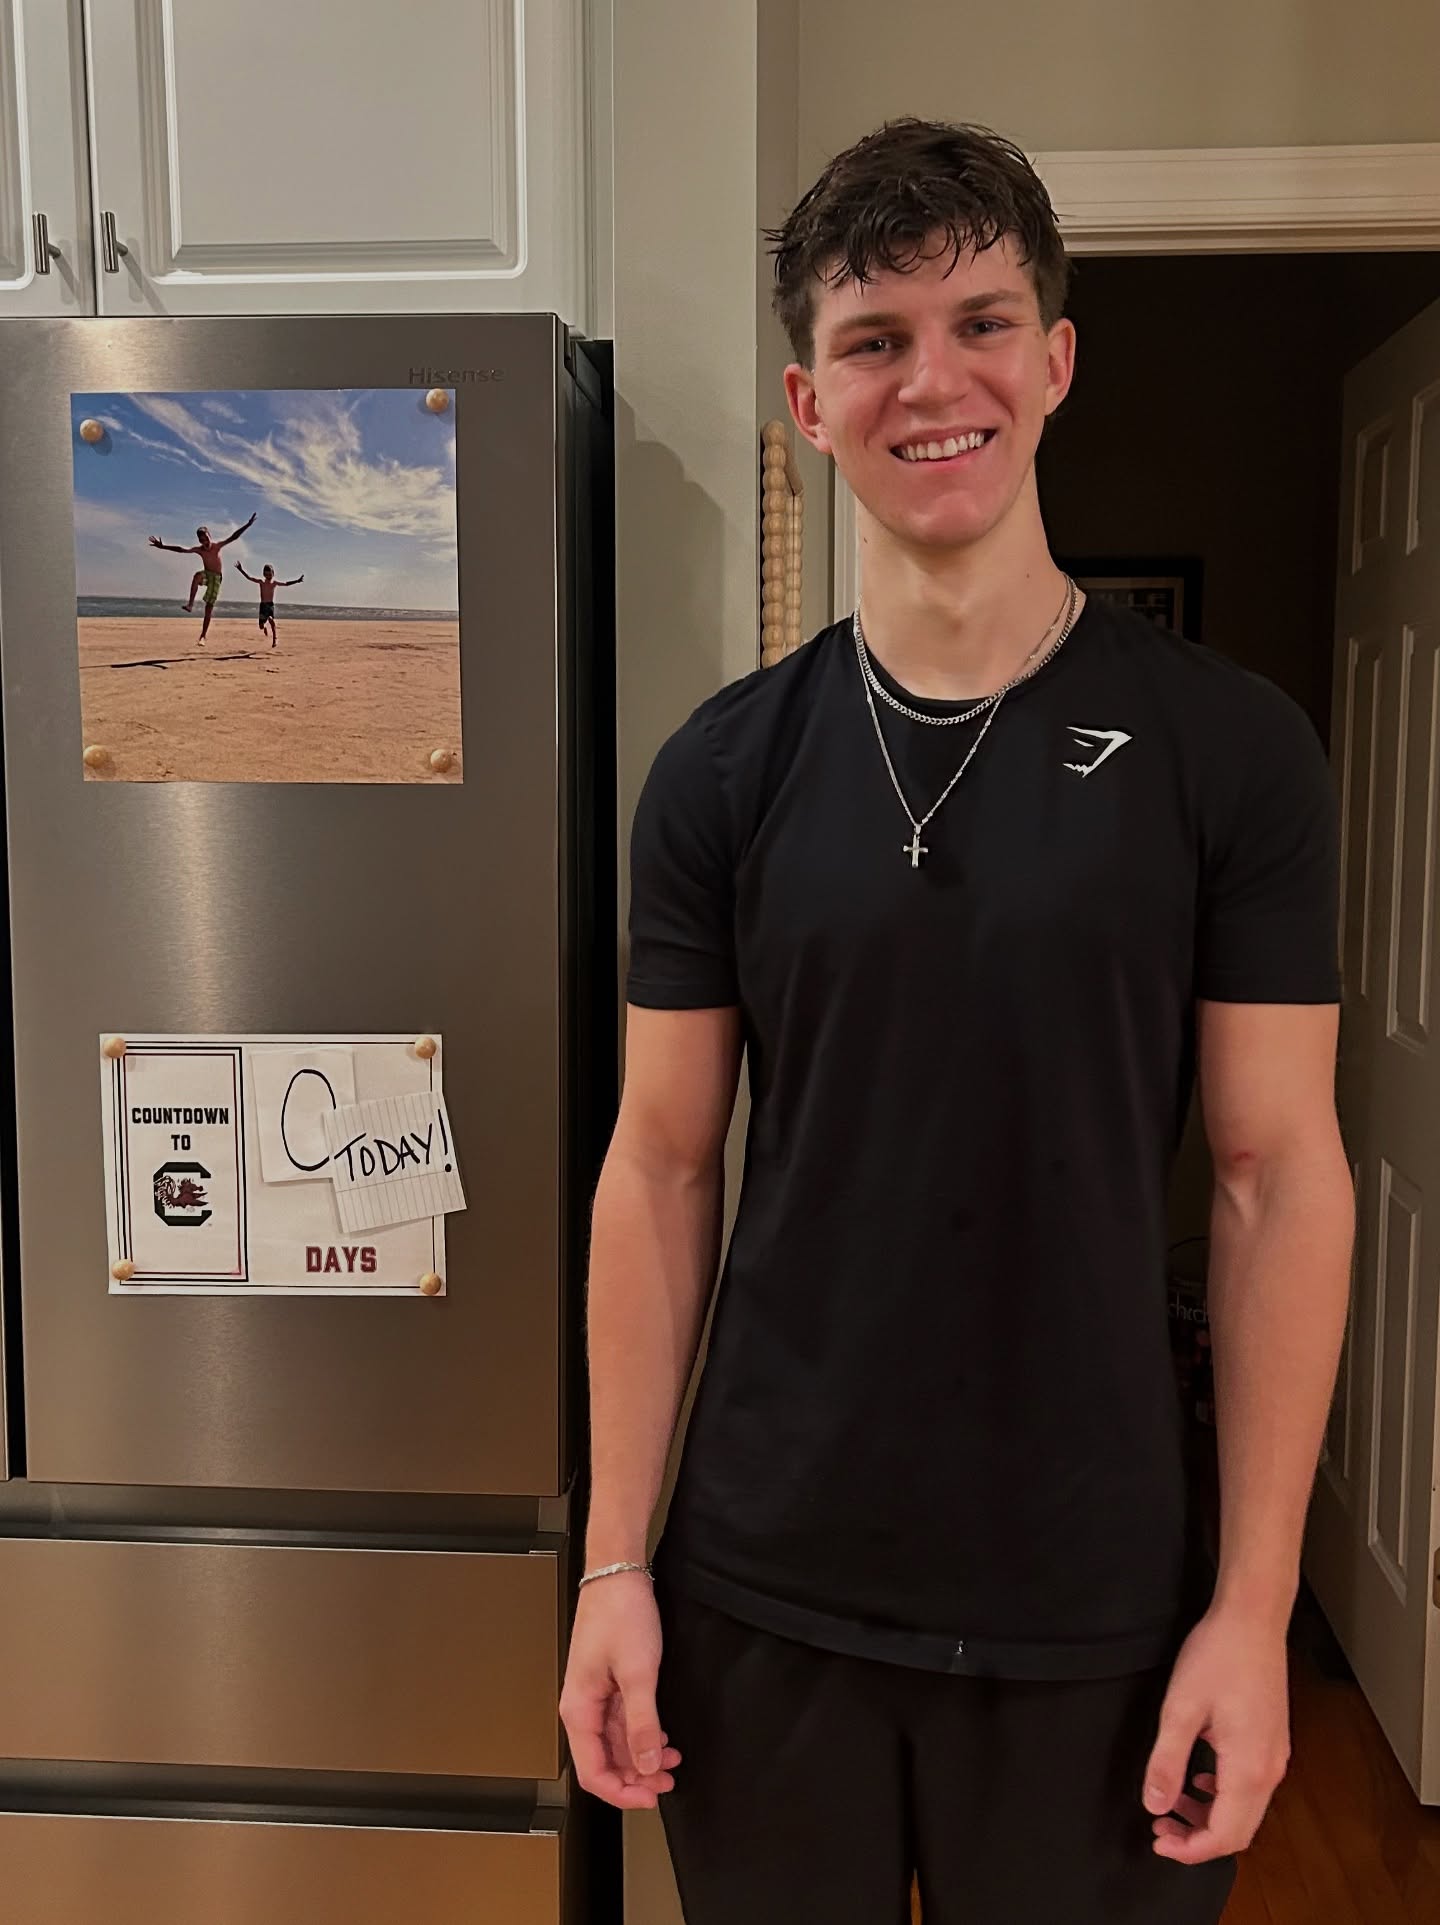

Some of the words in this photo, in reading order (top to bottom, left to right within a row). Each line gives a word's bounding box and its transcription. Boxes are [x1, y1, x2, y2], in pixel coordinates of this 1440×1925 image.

[408, 367, 504, 384] Hisense
[131, 1107, 229, 1124] COUNTDOWN
[170, 1134, 191, 1151] TO
[305, 1246, 378, 1273] DAYS
